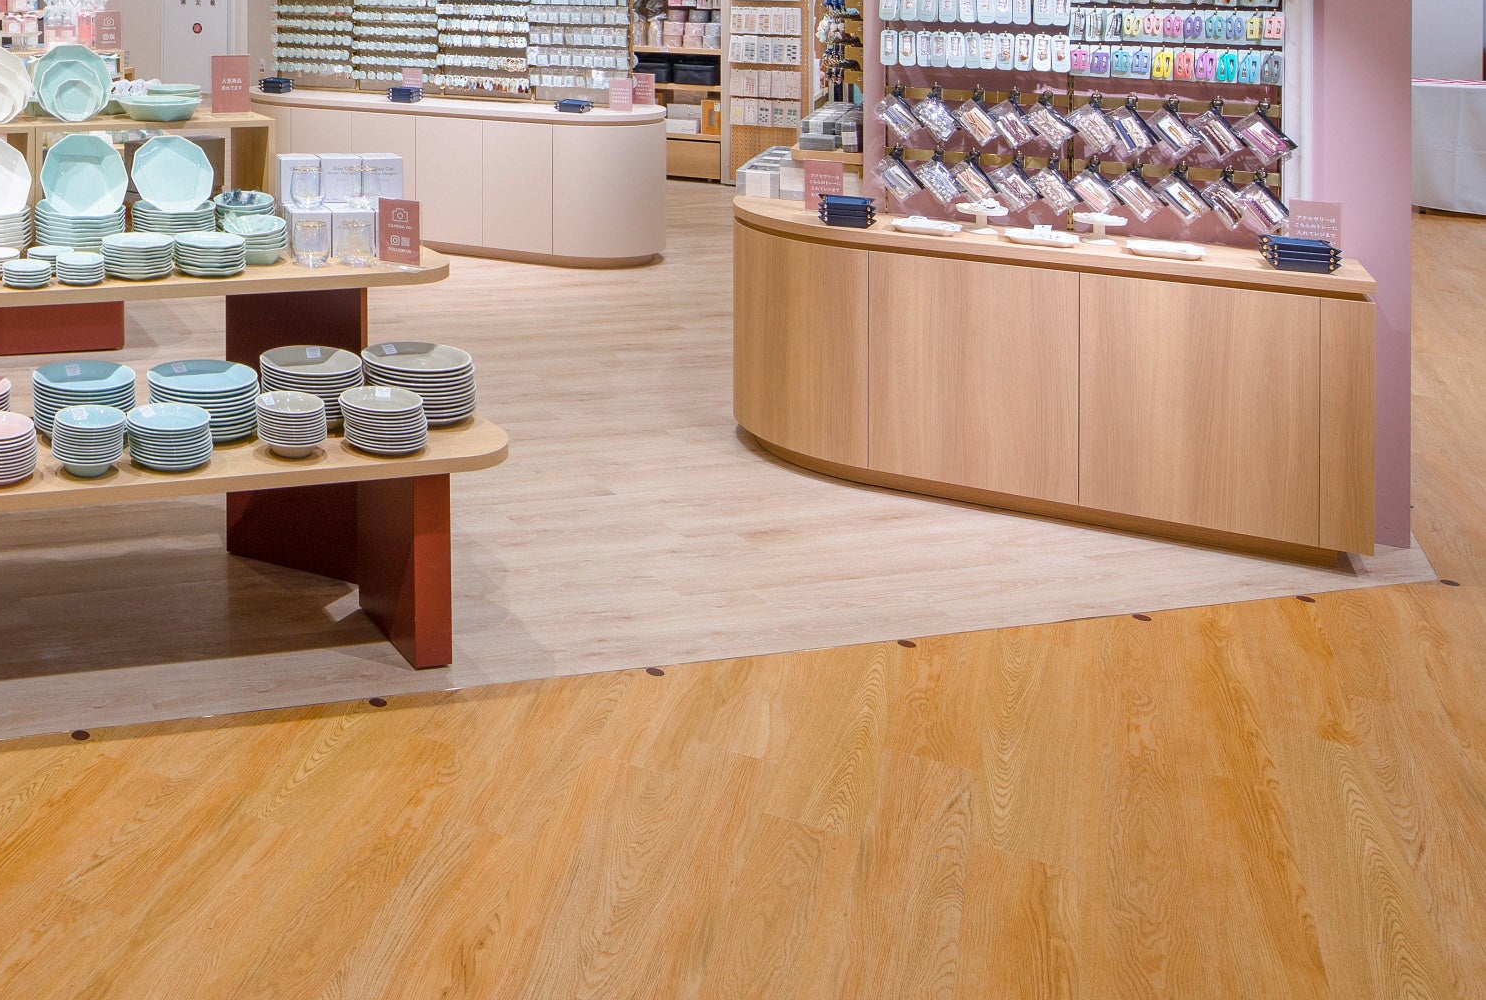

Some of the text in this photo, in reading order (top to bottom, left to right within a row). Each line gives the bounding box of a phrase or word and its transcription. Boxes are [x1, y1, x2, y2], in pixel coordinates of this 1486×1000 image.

[1296, 230, 1337, 239] 入れてレジまで
